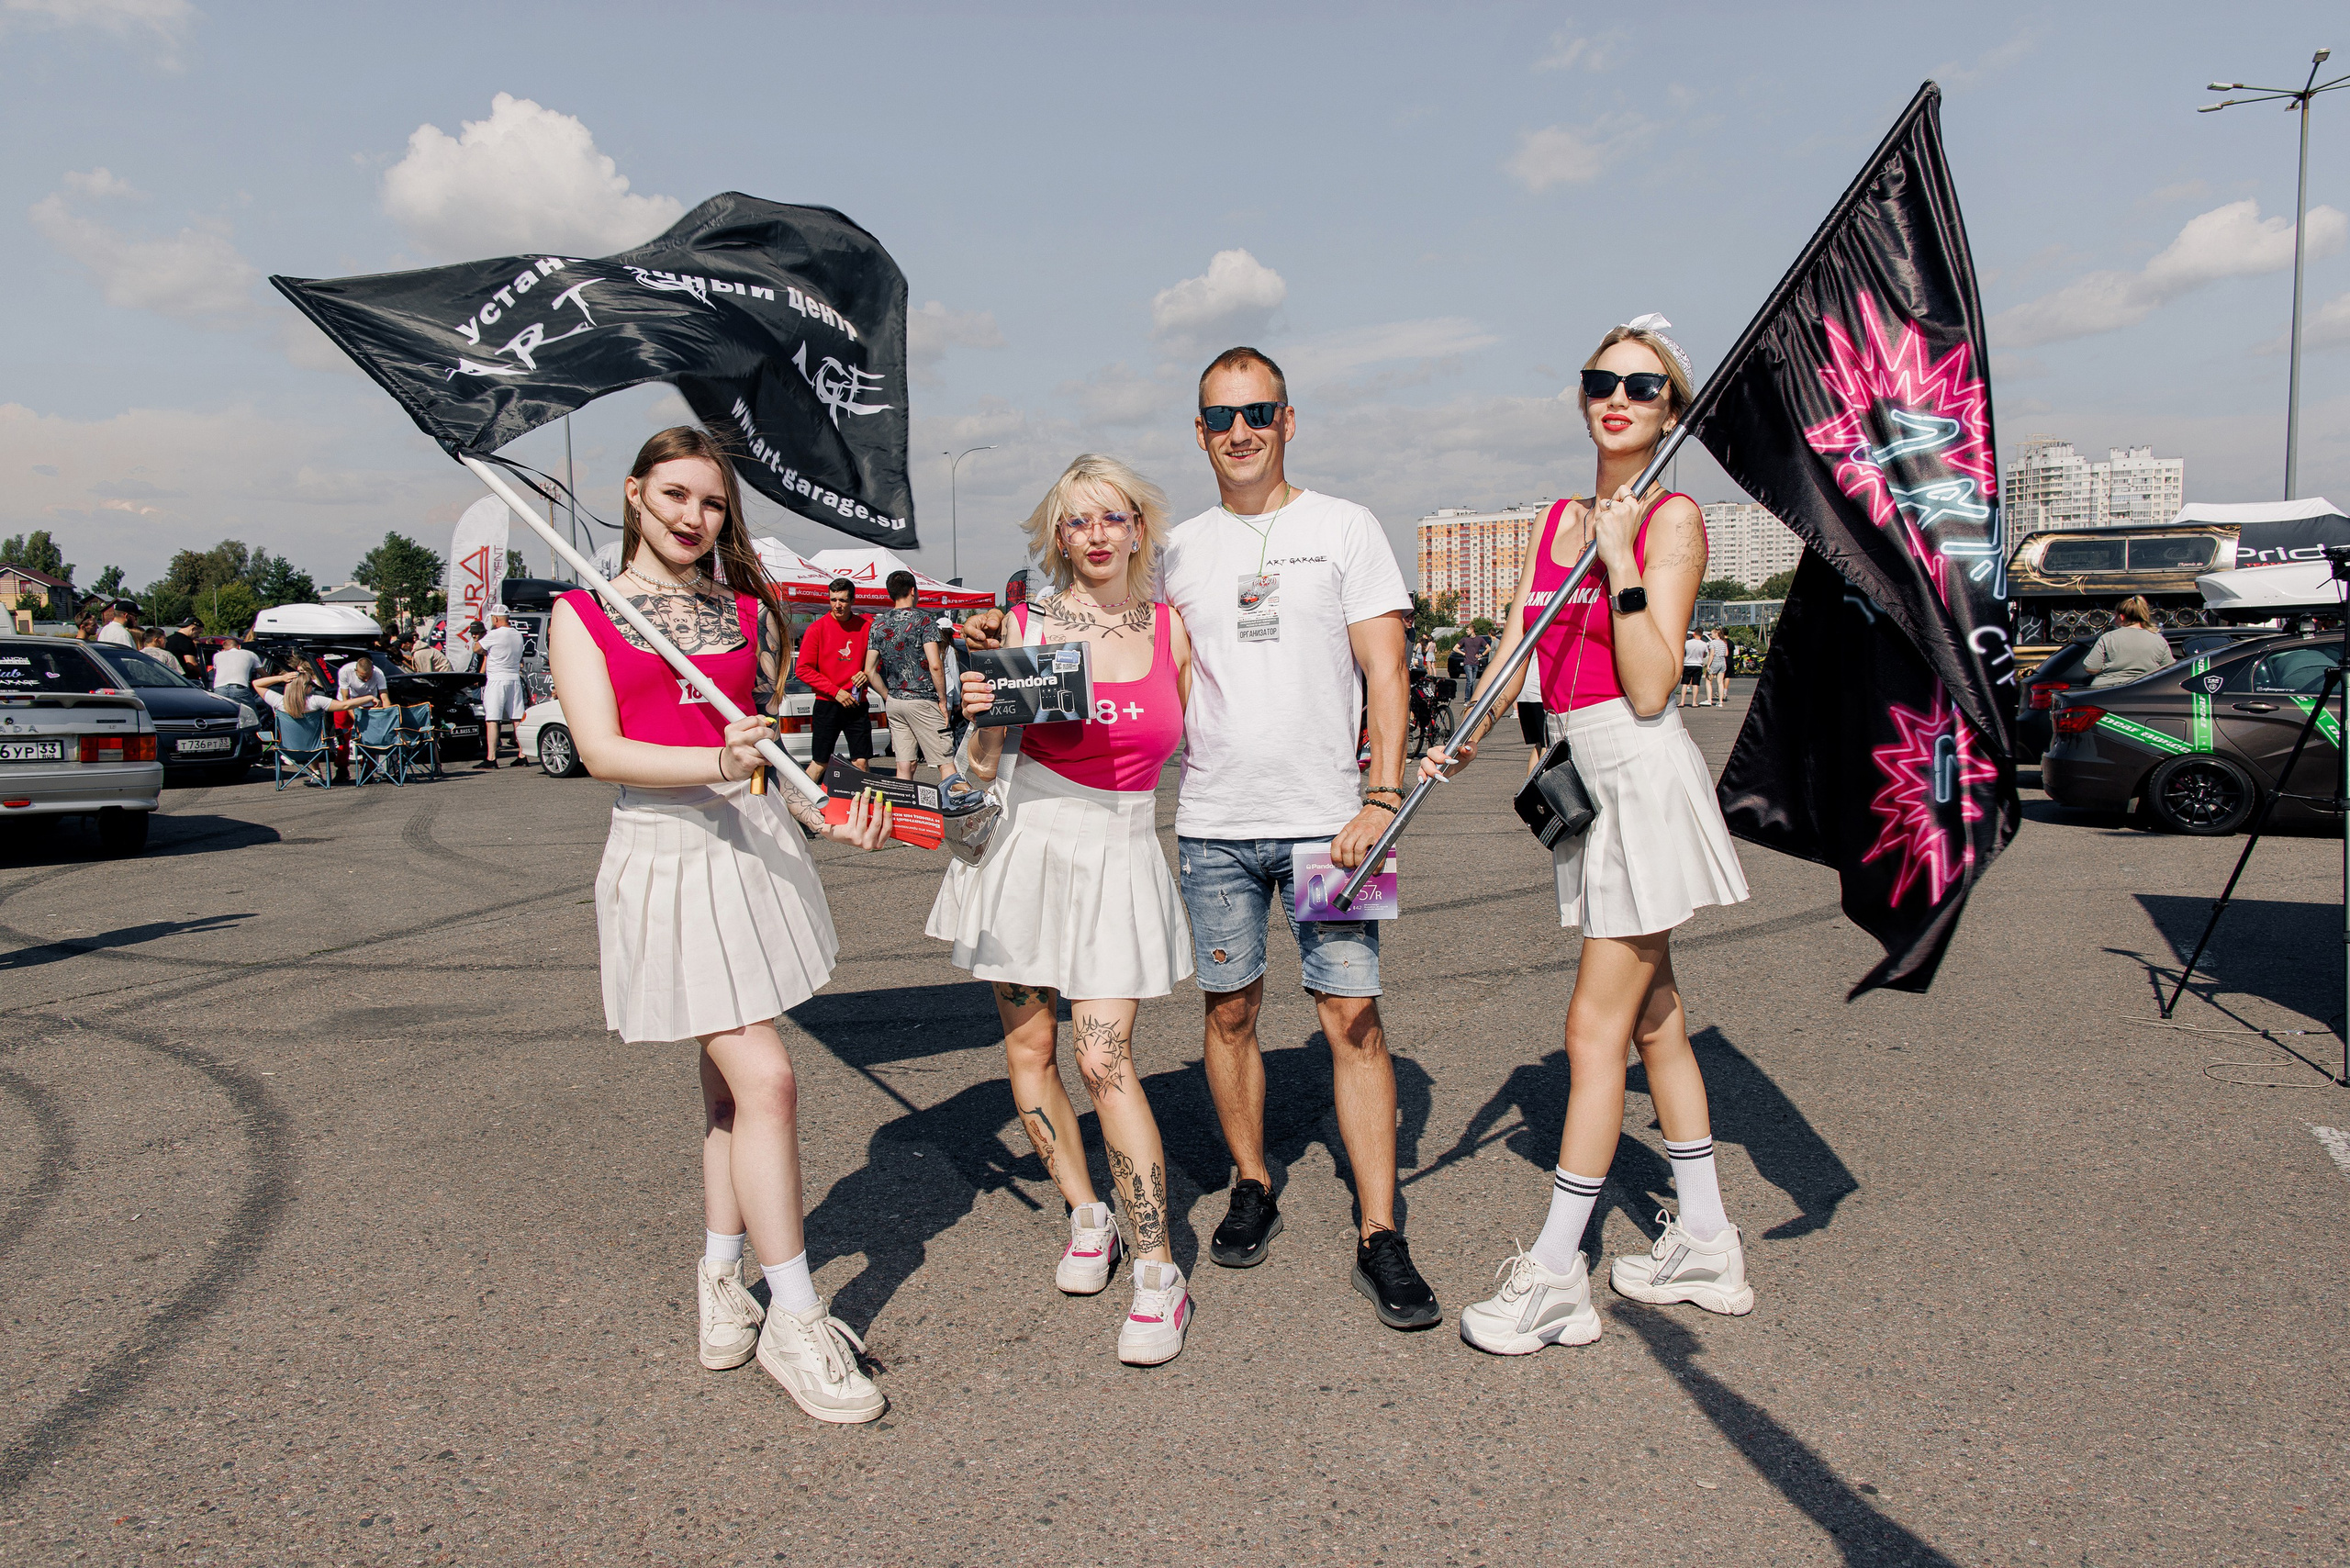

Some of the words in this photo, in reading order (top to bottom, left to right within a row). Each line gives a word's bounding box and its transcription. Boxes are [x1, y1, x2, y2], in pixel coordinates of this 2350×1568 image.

[454, 257, 566, 346] устан
[1239, 627, 1278, 639] ОРГАНИЗАТОР
[997, 675, 1058, 690] Pandora
[1002, 704, 1016, 714] 4G
[1085, 699, 1145, 725] 8+
[0, 724, 39, 734] ADA
[39, 743, 57, 754] 33
